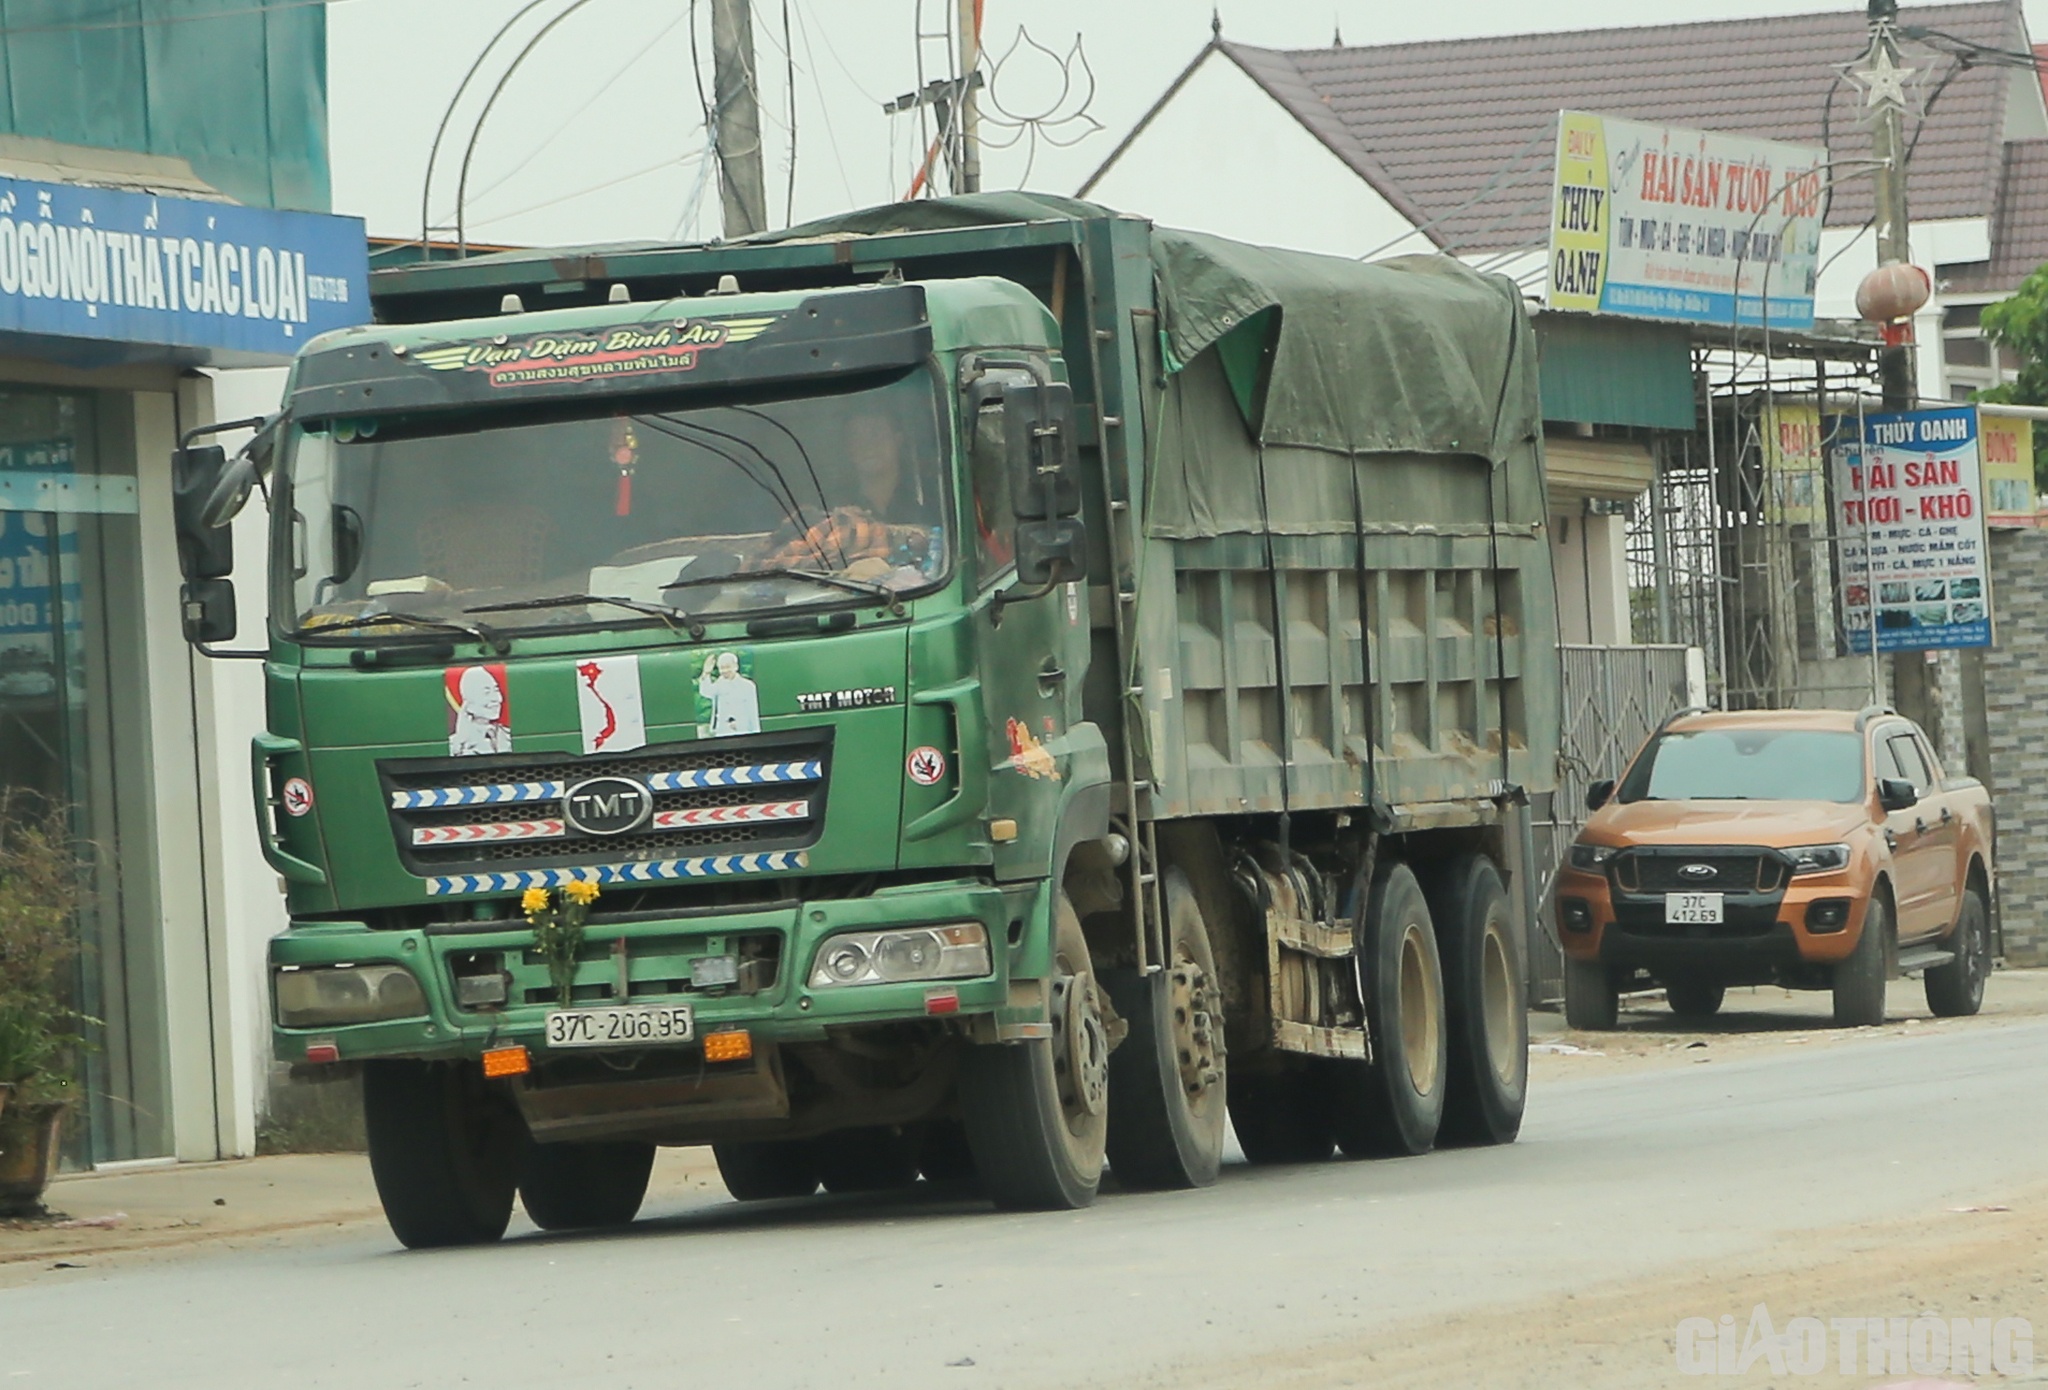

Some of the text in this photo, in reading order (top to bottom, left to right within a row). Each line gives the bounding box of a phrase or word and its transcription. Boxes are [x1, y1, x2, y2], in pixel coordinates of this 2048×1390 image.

[1555, 248, 1600, 295] OANH
[466, 324, 721, 367] Vạn Dặm Bình An
[1873, 416, 1915, 444] THỦY
[1920, 418, 1967, 442] OANH
[1904, 453, 1959, 487] SẢN
[1920, 489, 1973, 520] KHÔ
[797, 691, 833, 710] TMT
[572, 792, 639, 819] TMT
[1682, 896, 1707, 909] 37C
